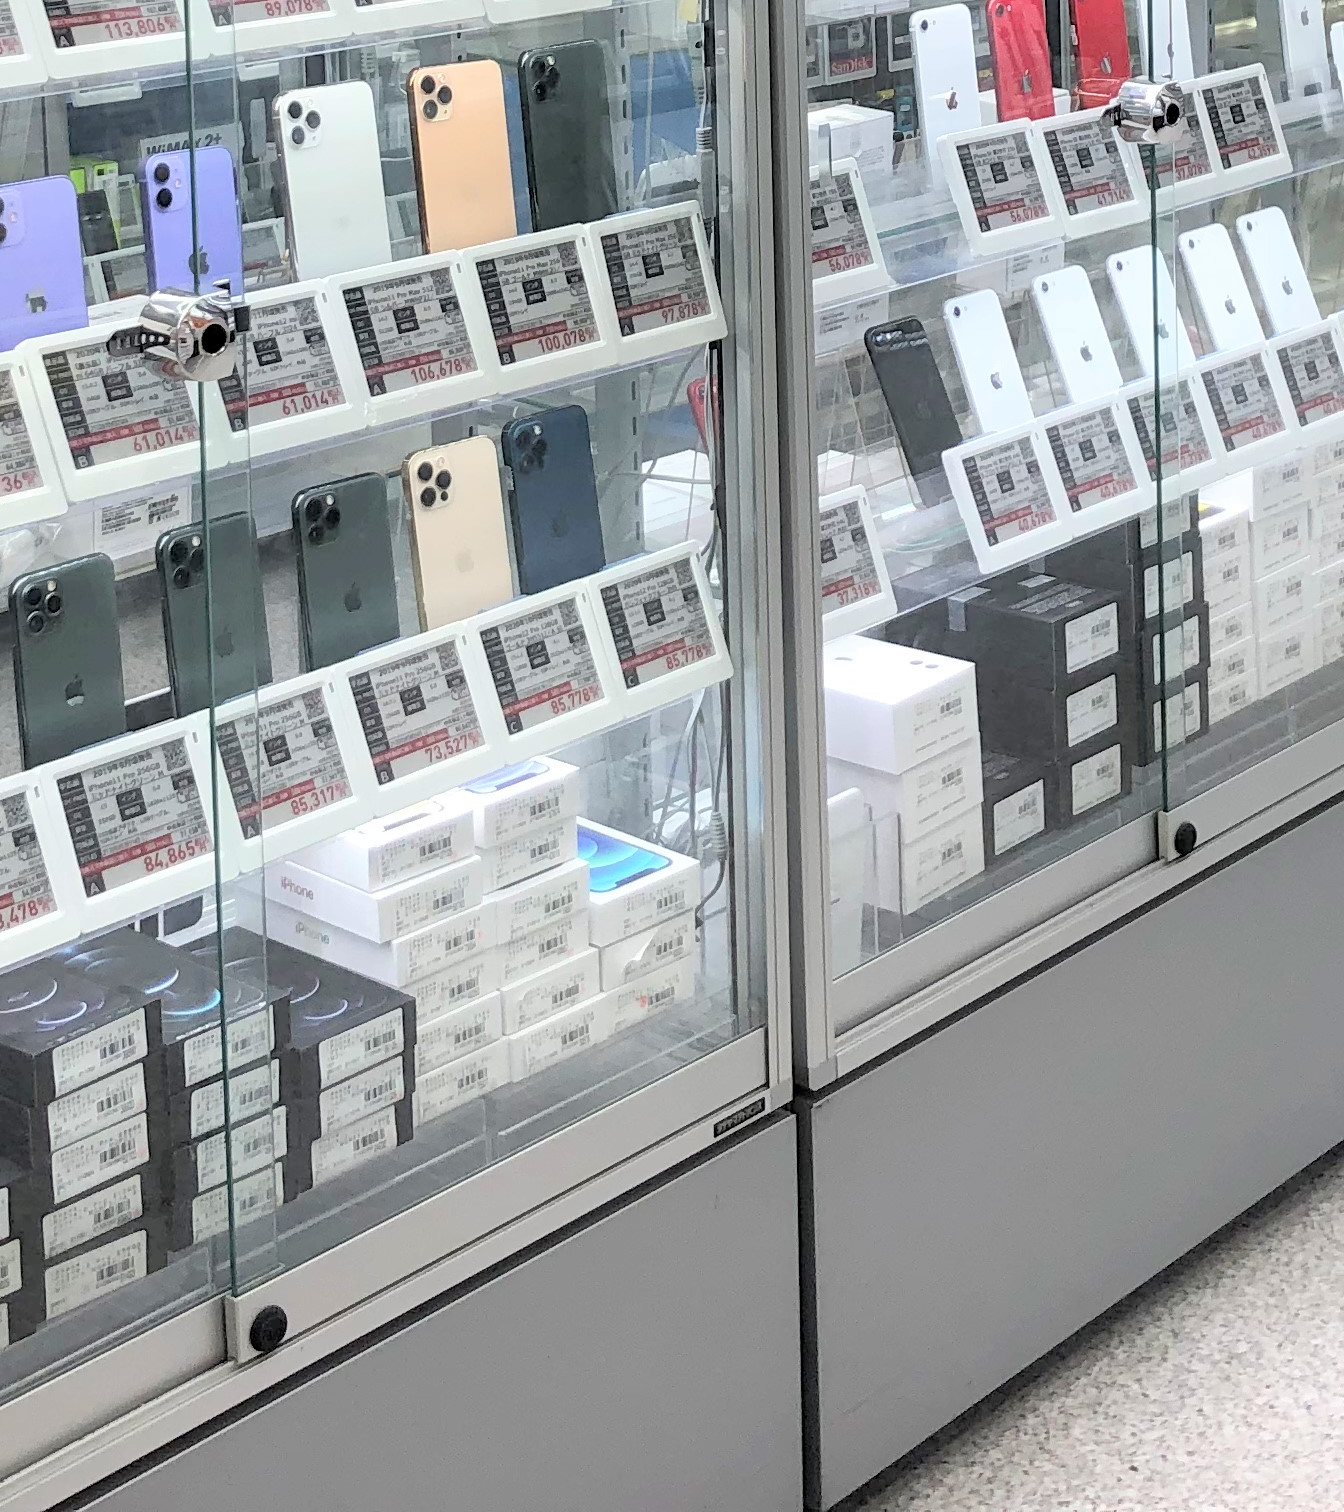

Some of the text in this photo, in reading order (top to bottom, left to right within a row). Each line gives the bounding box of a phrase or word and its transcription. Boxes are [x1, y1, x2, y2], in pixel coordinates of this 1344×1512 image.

[830, 56, 872, 74] SanDisk
[280, 876, 315, 902] iPhone
[295, 920, 331, 945] iPhone
